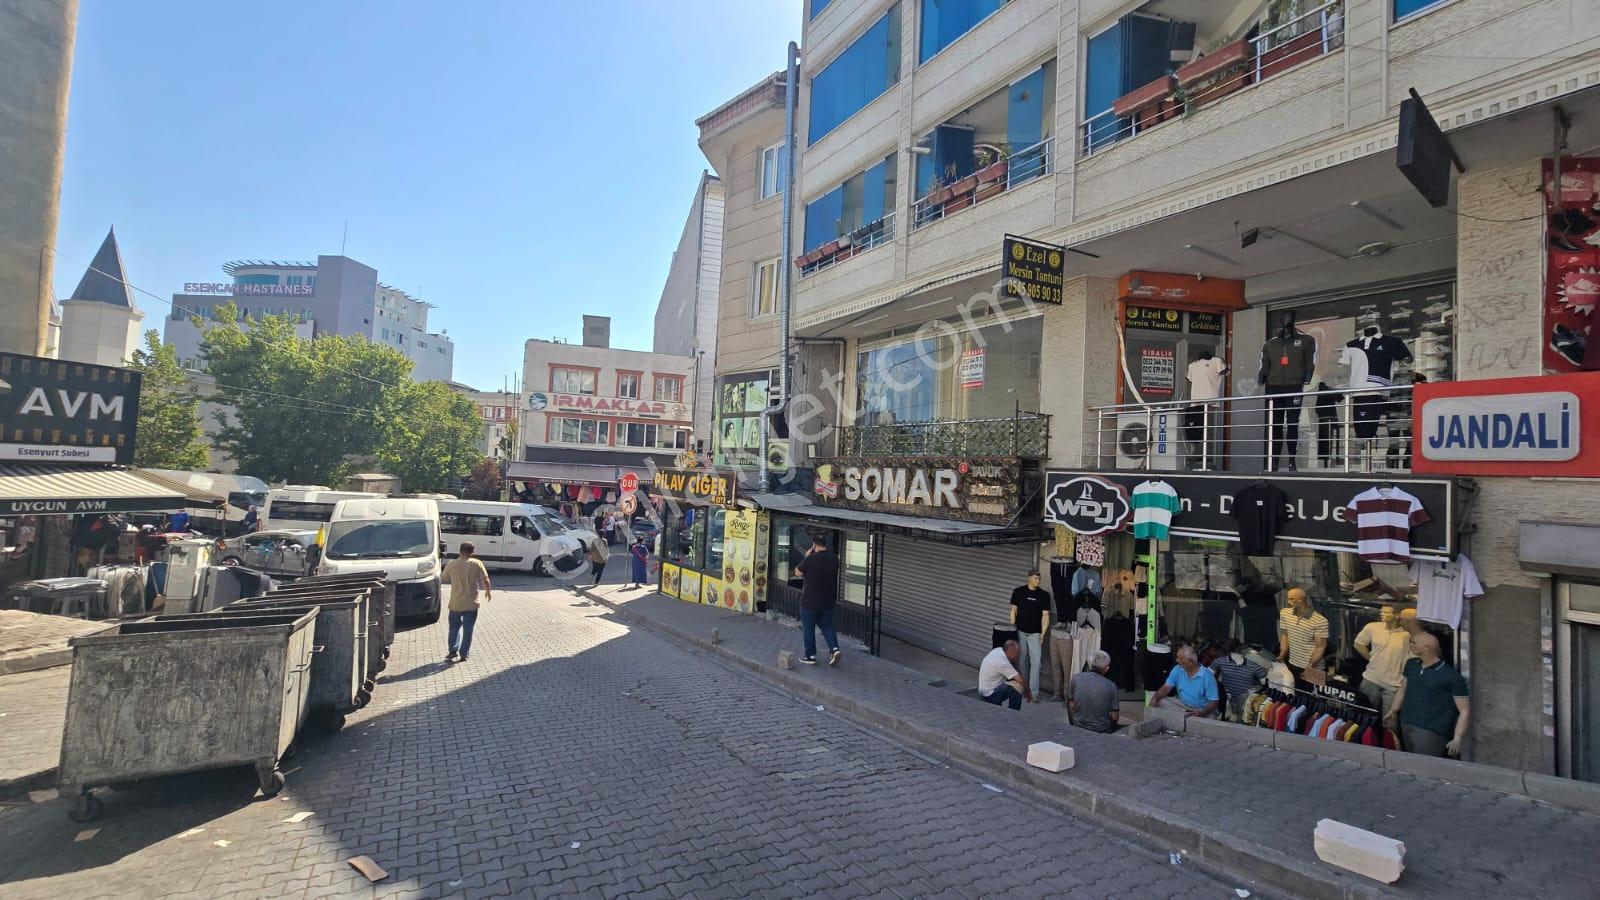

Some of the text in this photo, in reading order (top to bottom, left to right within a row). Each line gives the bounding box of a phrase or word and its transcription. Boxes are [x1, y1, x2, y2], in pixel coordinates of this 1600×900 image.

[1026, 246, 1046, 264] Ezel
[1008, 262, 1062, 285] Mersin Tantuni
[184, 282, 239, 294] ESENCAN
[1027, 283, 1041, 298] 905
[1041, 286, 1051, 301] 90
[1052, 288, 1061, 303] 33
[1142, 309, 1161, 319] Ezel
[19, 387, 124, 421] AVM
[1429, 402, 1570, 449] JANDALİ
[18, 447, 59, 457] Esenyurt
[622, 480, 637, 488] DUR
[844, 466, 962, 509] SOMAR
[76, 500, 107, 510] AVM
[1055, 498, 1115, 524] WDJ
